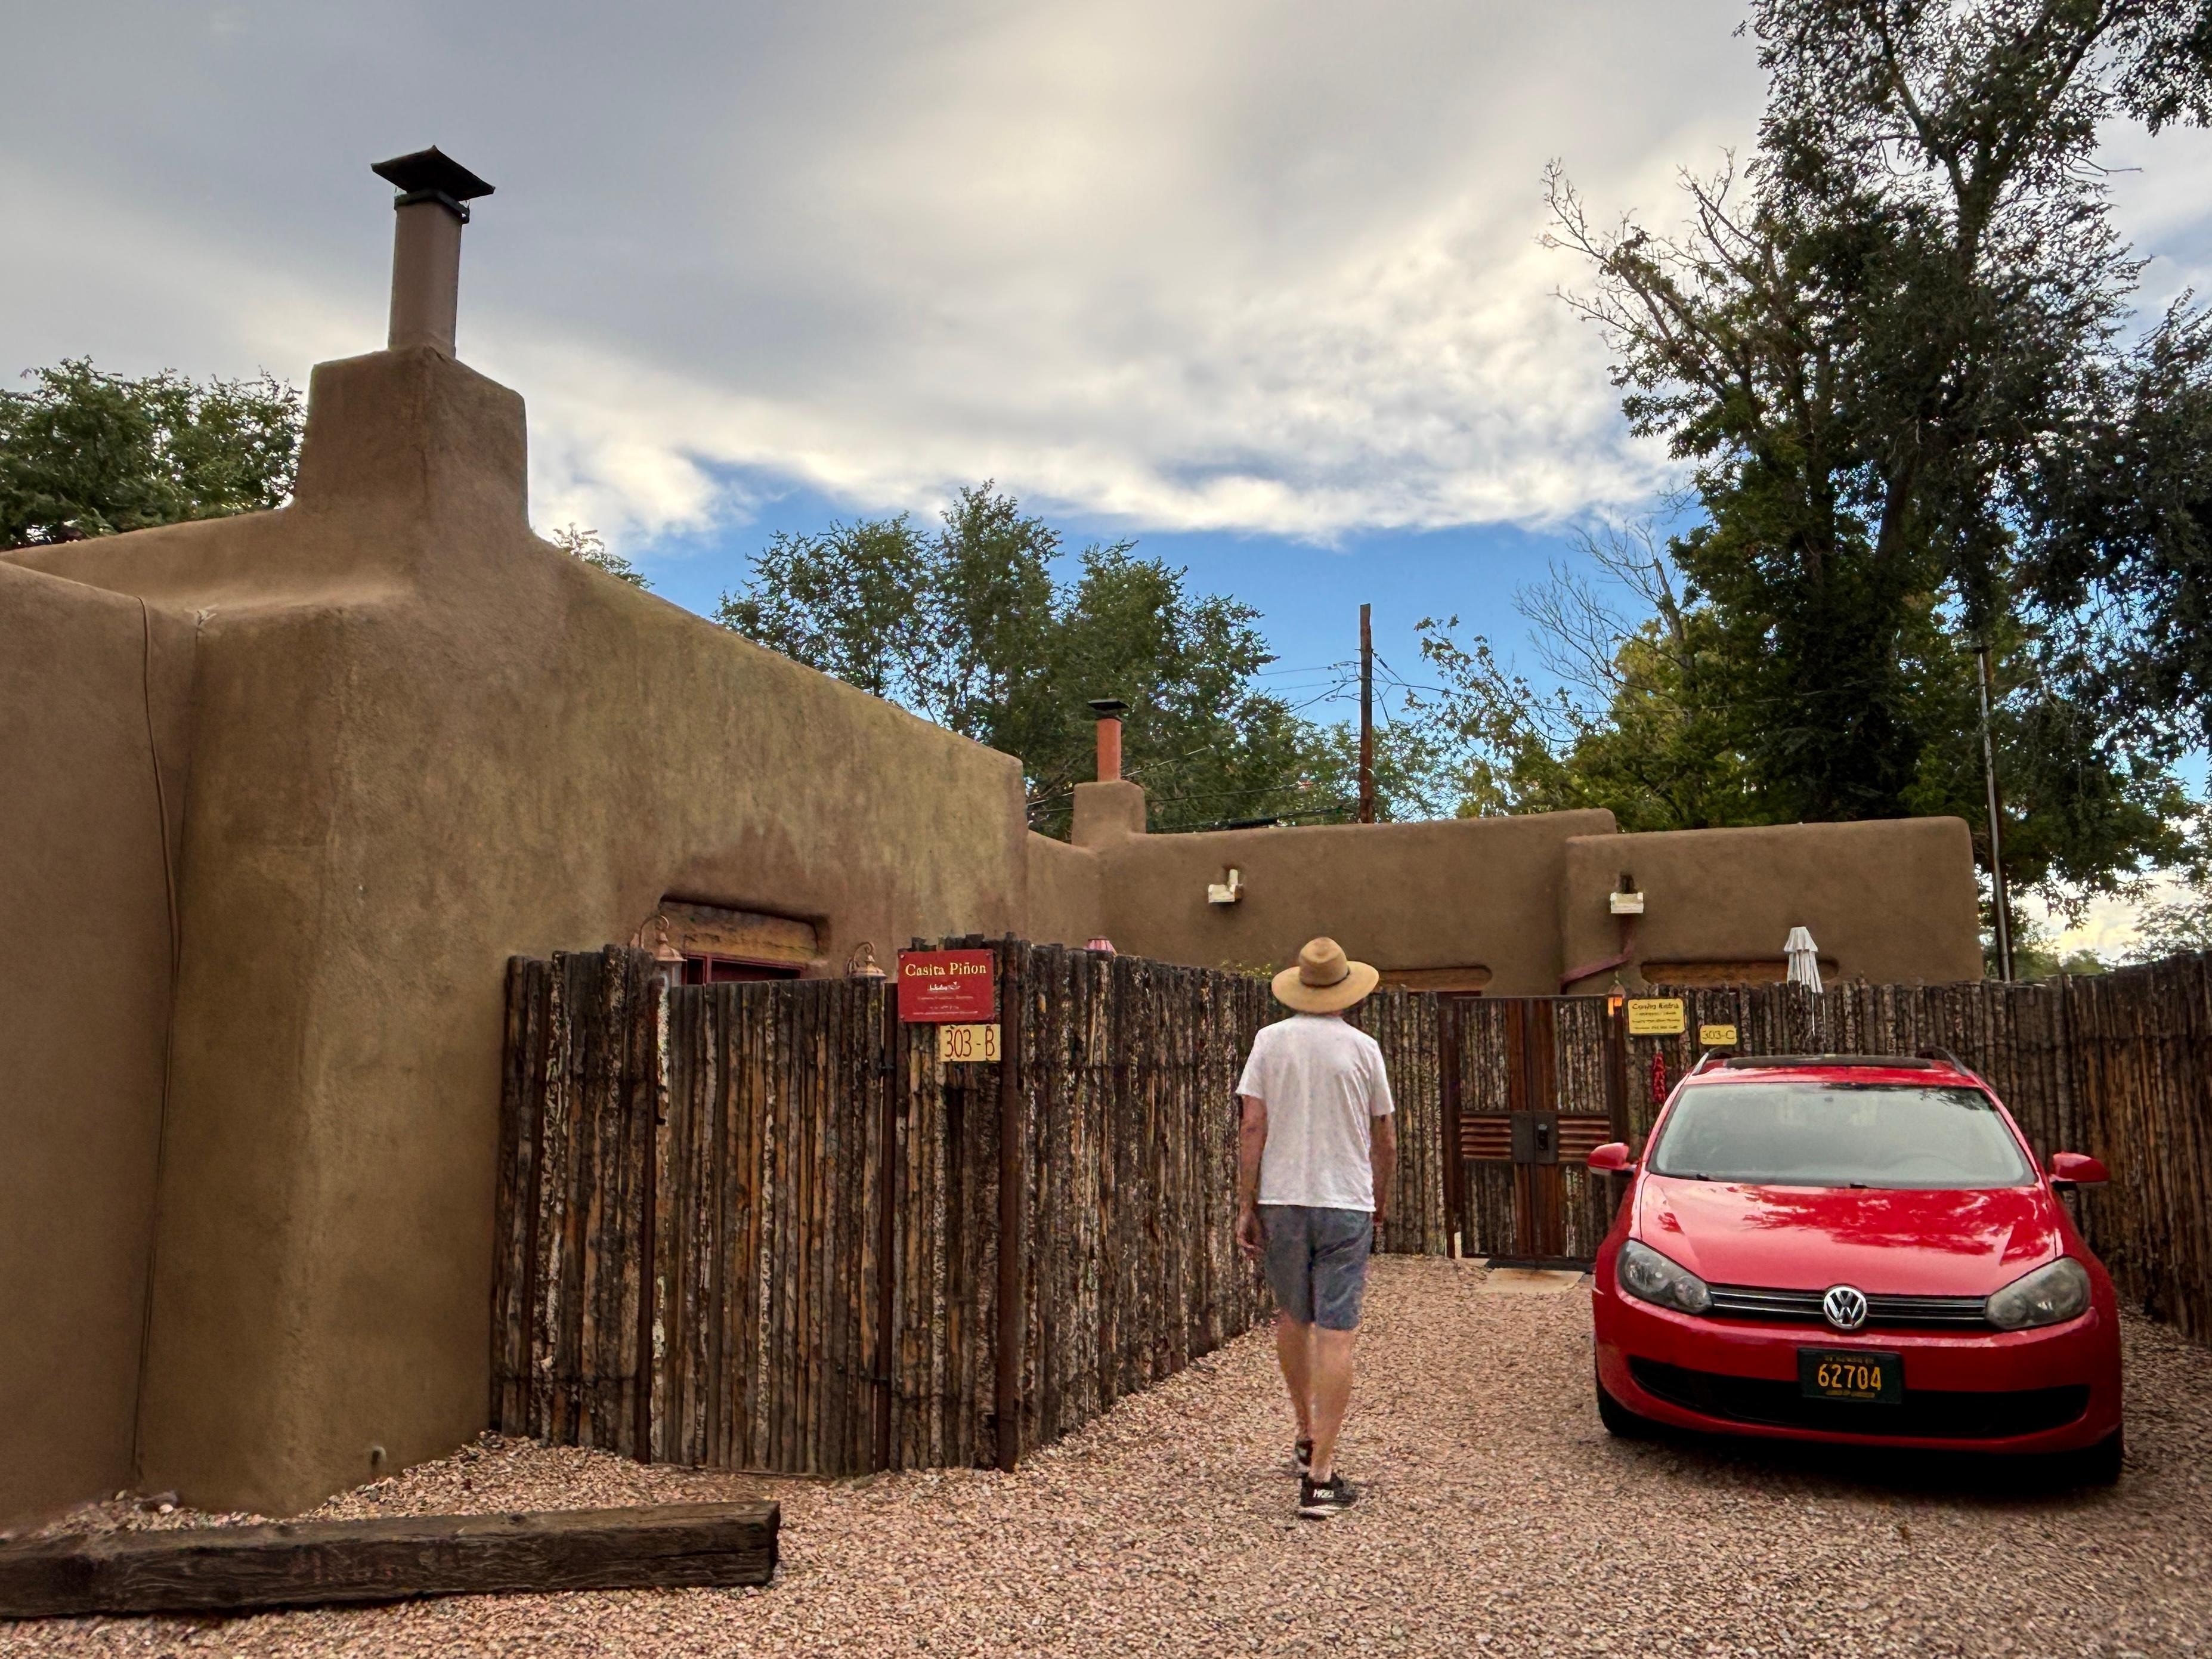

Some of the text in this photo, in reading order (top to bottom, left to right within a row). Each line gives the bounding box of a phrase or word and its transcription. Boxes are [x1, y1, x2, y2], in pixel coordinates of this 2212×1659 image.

[905, 962, 986, 976] Casita Piñon
[1701, 1029, 1735, 1041] 303-C
[1824, 1286, 1867, 1329] VW
[1818, 1363, 1882, 1391] 62704
